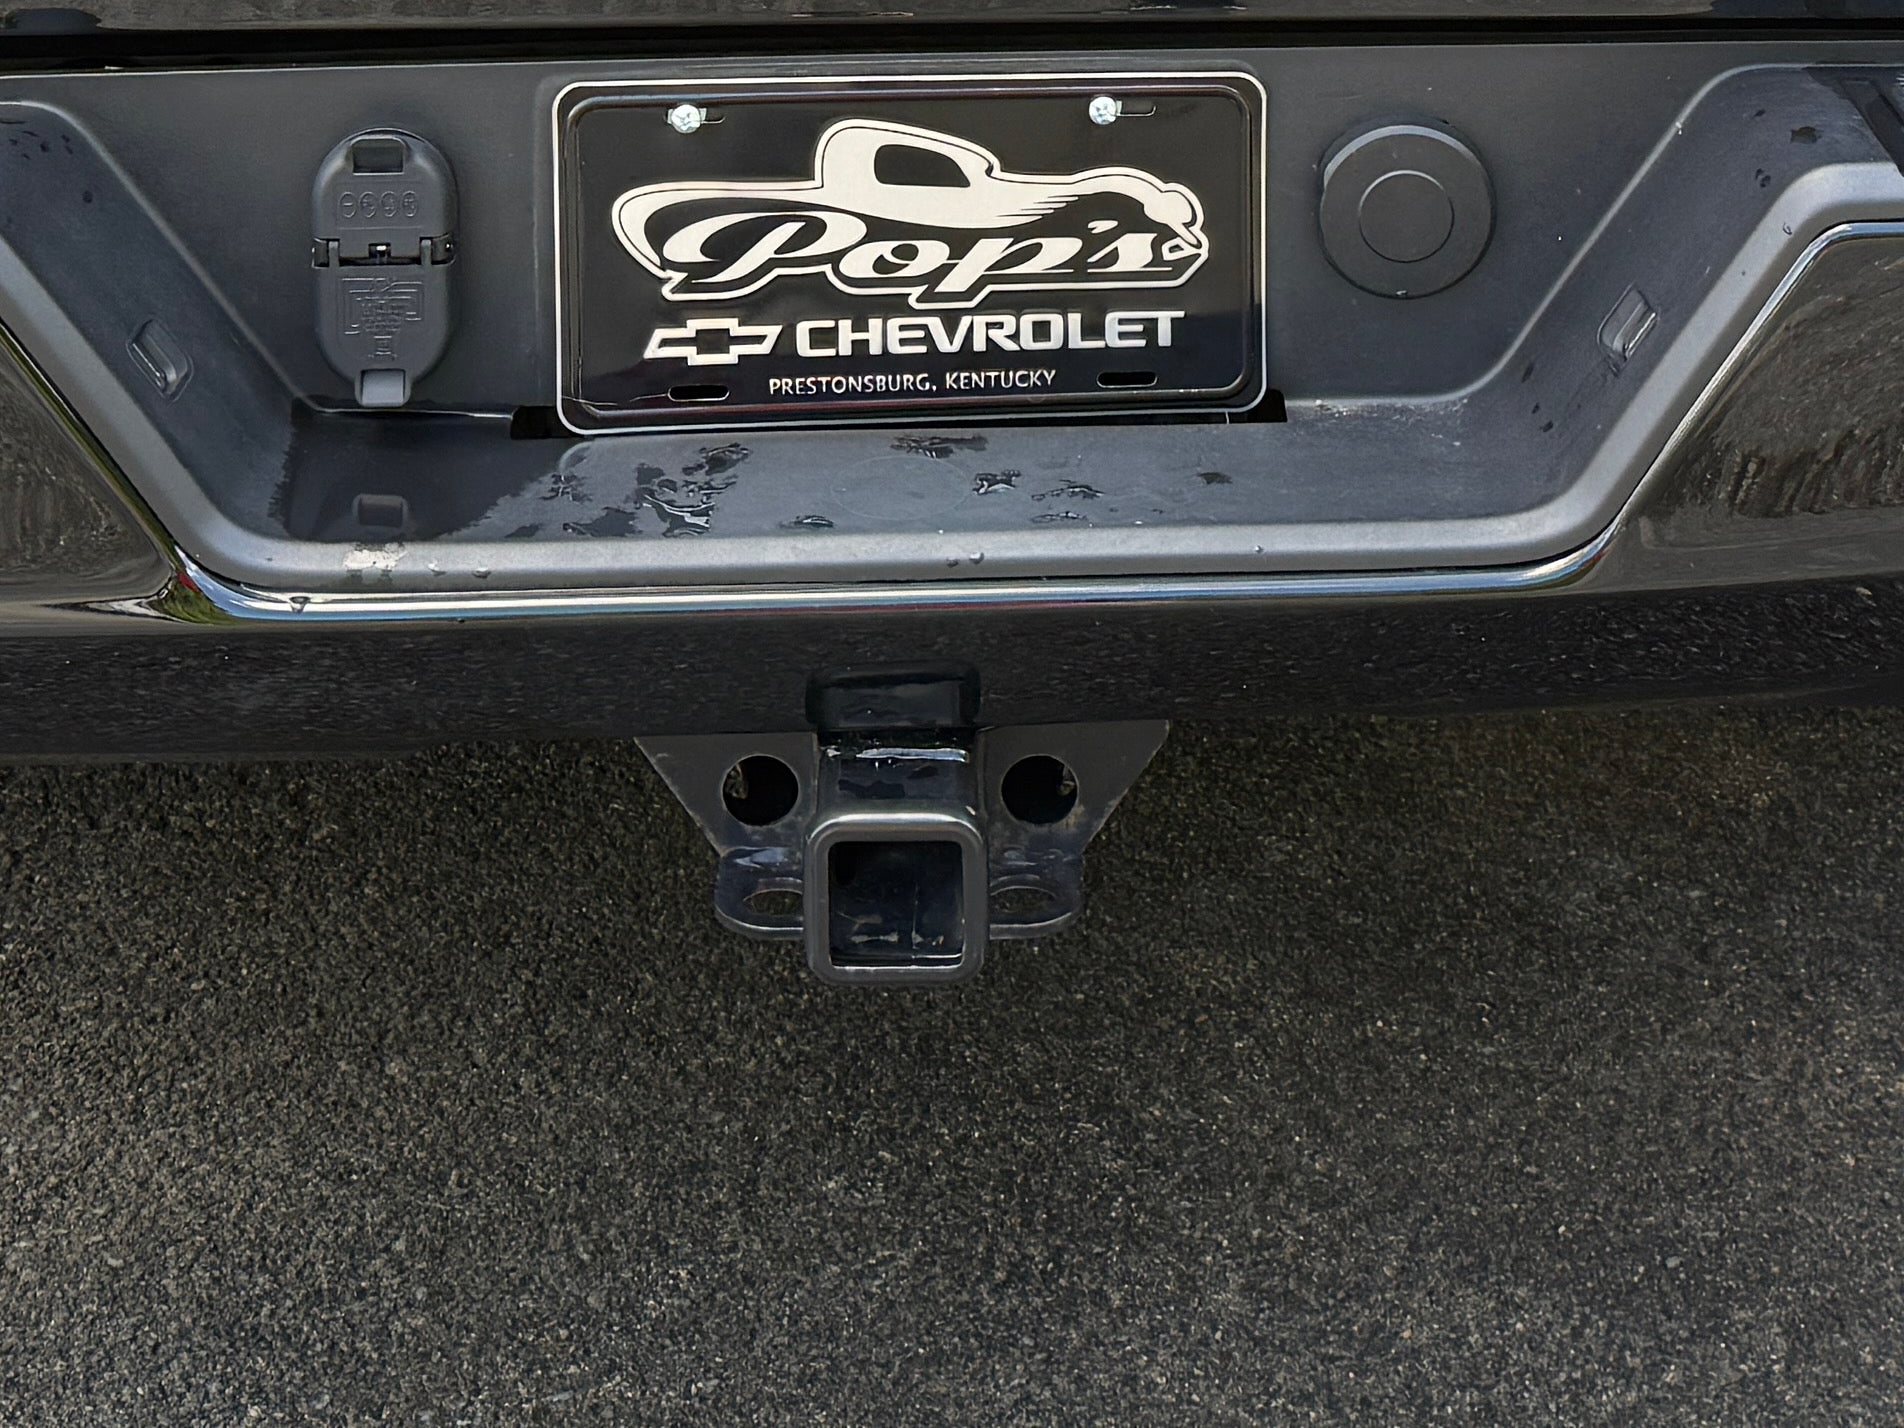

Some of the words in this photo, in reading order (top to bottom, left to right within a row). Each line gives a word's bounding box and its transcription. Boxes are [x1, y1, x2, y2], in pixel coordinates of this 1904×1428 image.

[662, 211, 1174, 293] Pop's
[795, 309, 1186, 358] CHEVROLET
[768, 372, 938, 396] PRESTONSBURG,
[945, 368, 1057, 390] KENTUCKY
